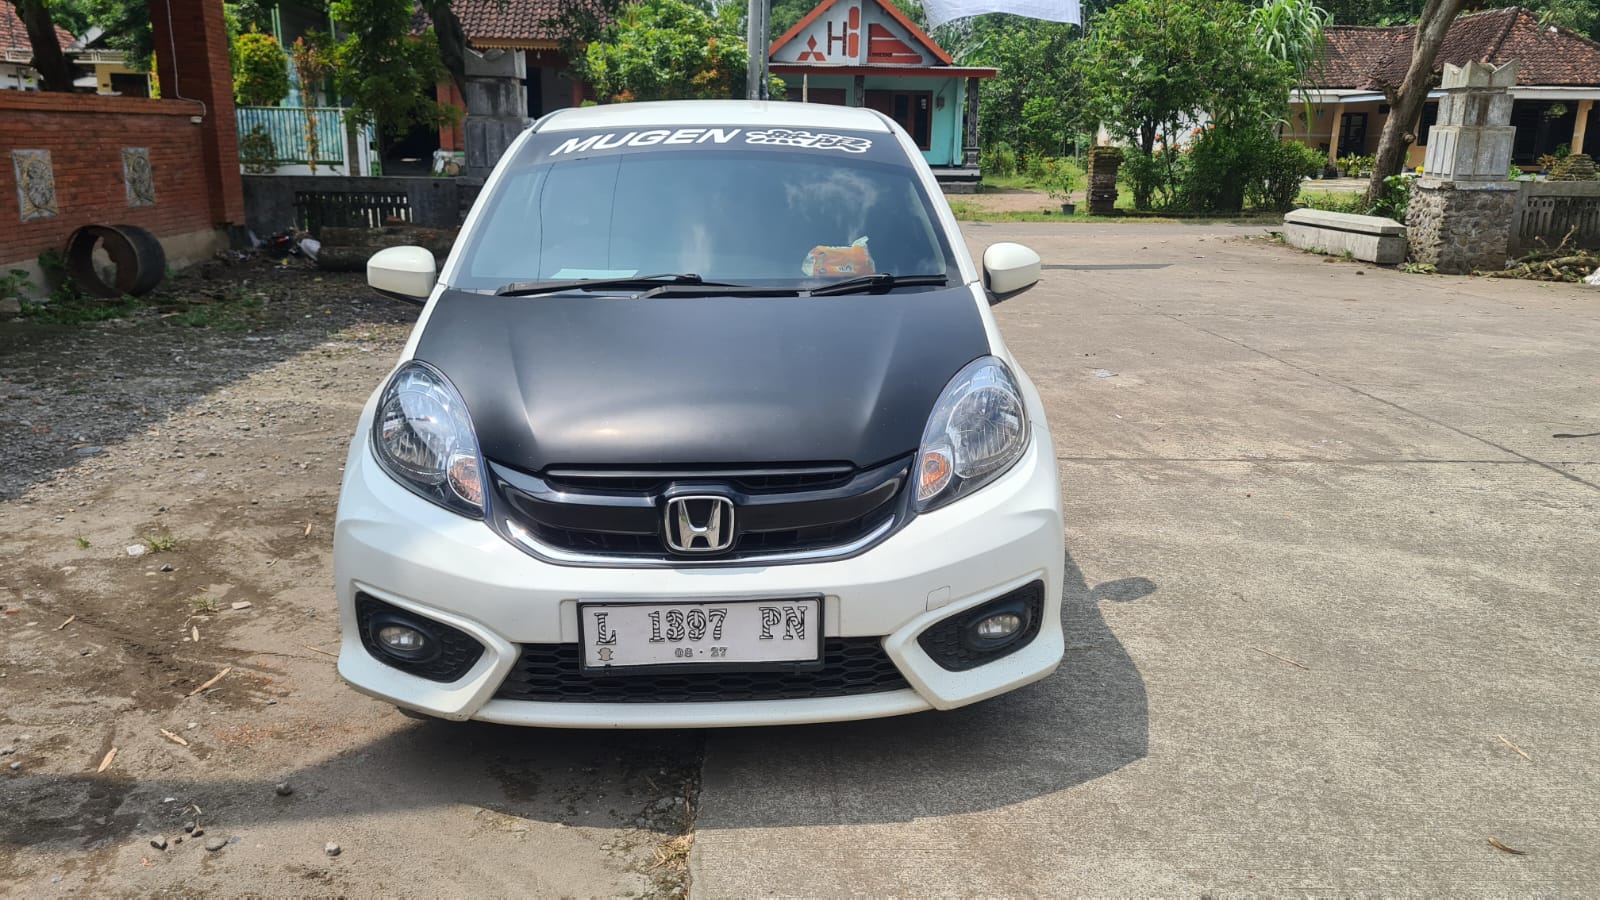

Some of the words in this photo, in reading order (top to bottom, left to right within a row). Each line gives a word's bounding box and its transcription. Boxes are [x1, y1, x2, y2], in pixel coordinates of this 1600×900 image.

[550, 128, 741, 156] MUGEN
[594, 612, 616, 645] L
[648, 608, 727, 642] 1397
[759, 606, 808, 640] PN
